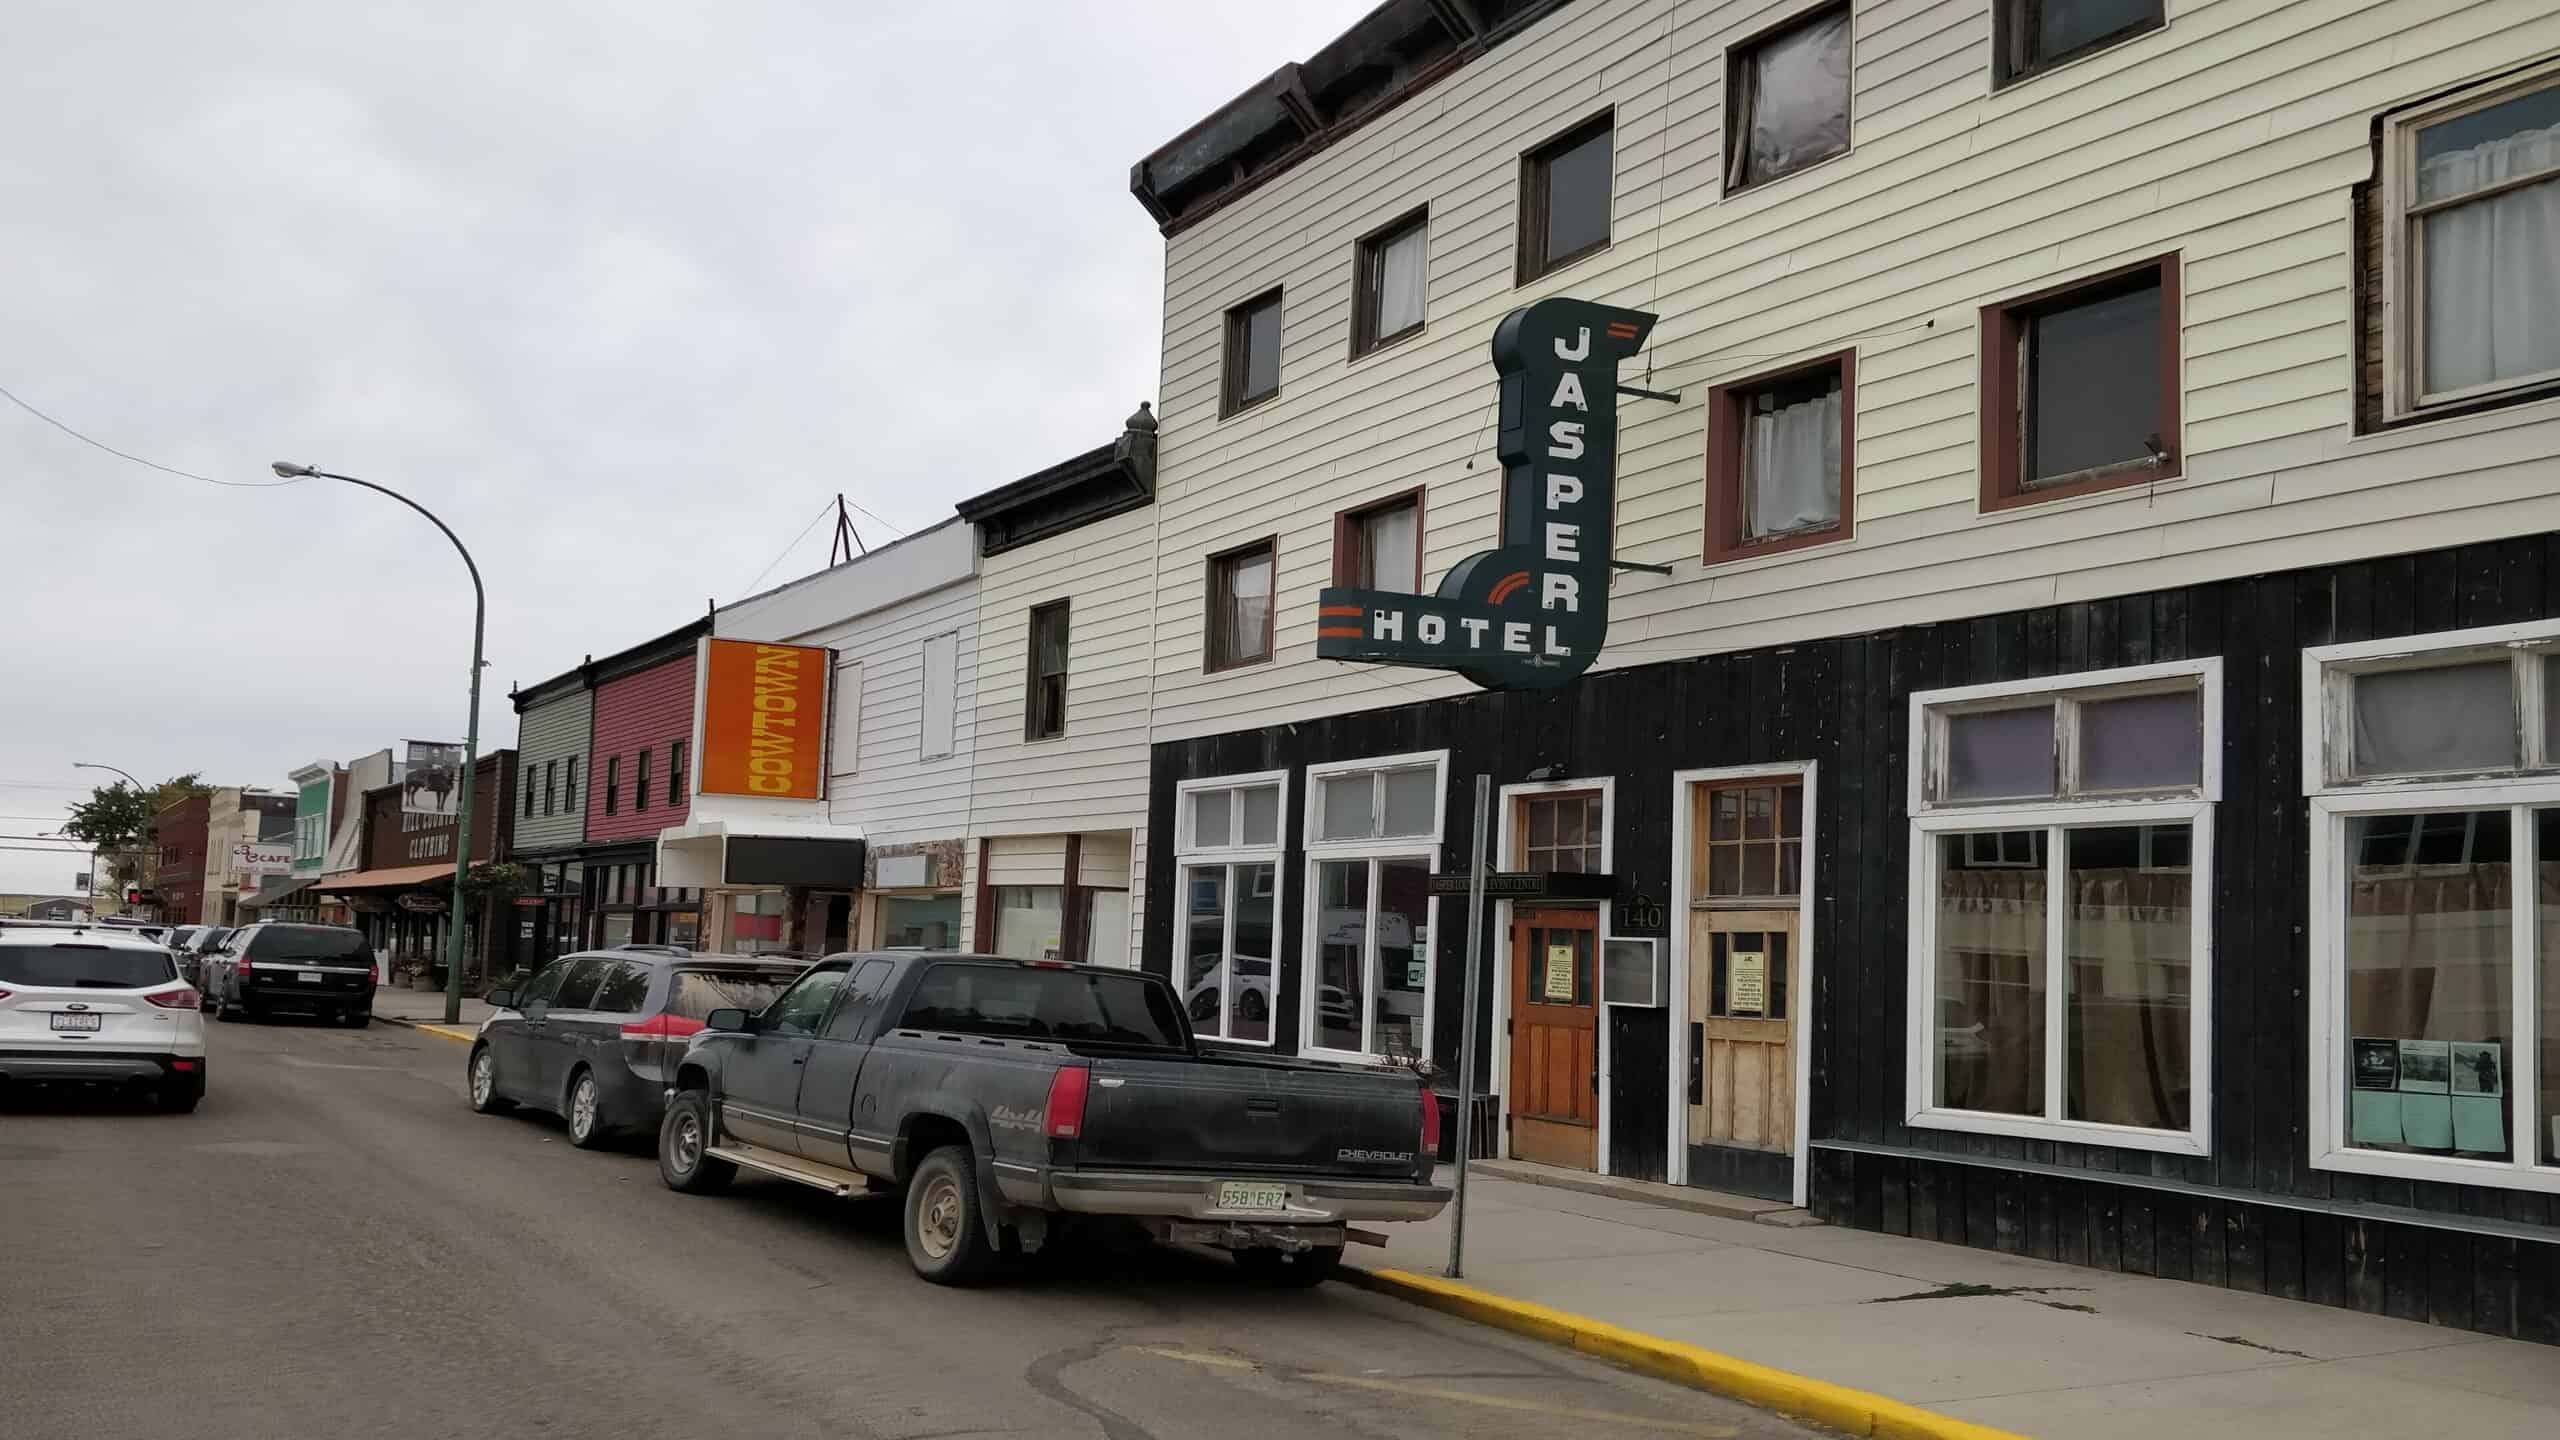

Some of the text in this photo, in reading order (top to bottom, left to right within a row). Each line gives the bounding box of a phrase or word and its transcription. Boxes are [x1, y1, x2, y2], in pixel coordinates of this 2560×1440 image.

[1543, 327, 1590, 612] JASPER
[1373, 609, 1571, 656] HOTEL
[749, 646, 800, 793] COWTOWN
[260, 855, 291, 863] CAFE
[409, 834, 449, 859] CLOTHING
[1623, 907, 1661, 928] 140
[1337, 1148, 1415, 1162] CHEVROLET
